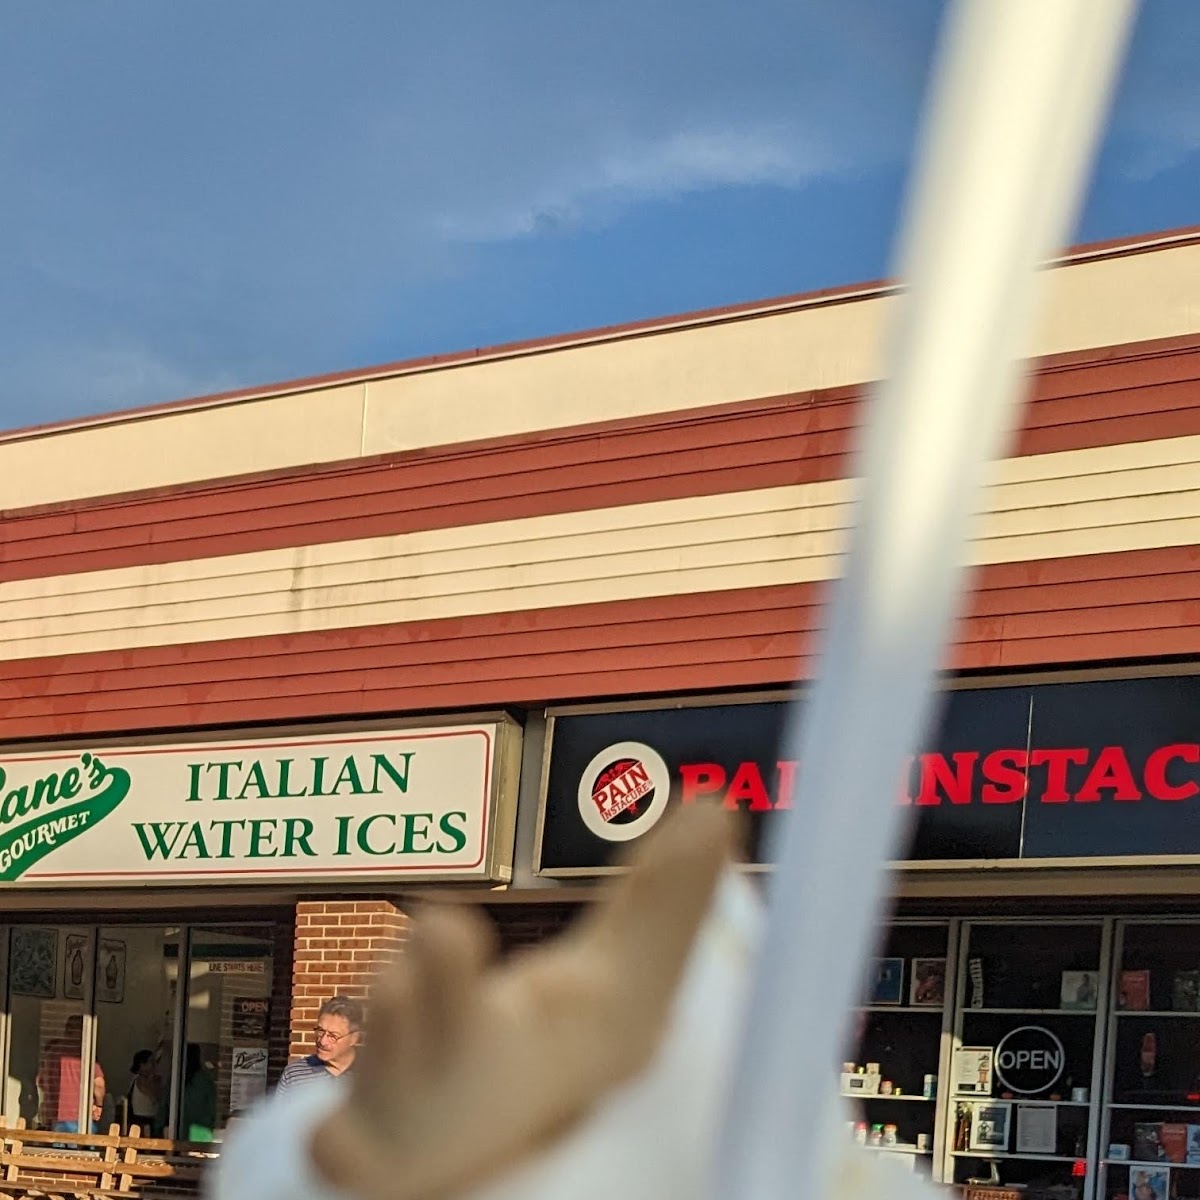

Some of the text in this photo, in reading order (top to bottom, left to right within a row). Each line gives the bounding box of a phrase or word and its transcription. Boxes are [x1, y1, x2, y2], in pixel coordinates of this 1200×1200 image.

[184, 752, 416, 803] ITALIAN
[592, 761, 649, 813] PAIN
[601, 783, 650, 822] INSTACURE
[679, 761, 799, 811] PAI
[131, 811, 467, 861] WATER ICES
[241, 1001, 269, 1013] OPEN
[999, 1050, 1060, 1070] OPEN
